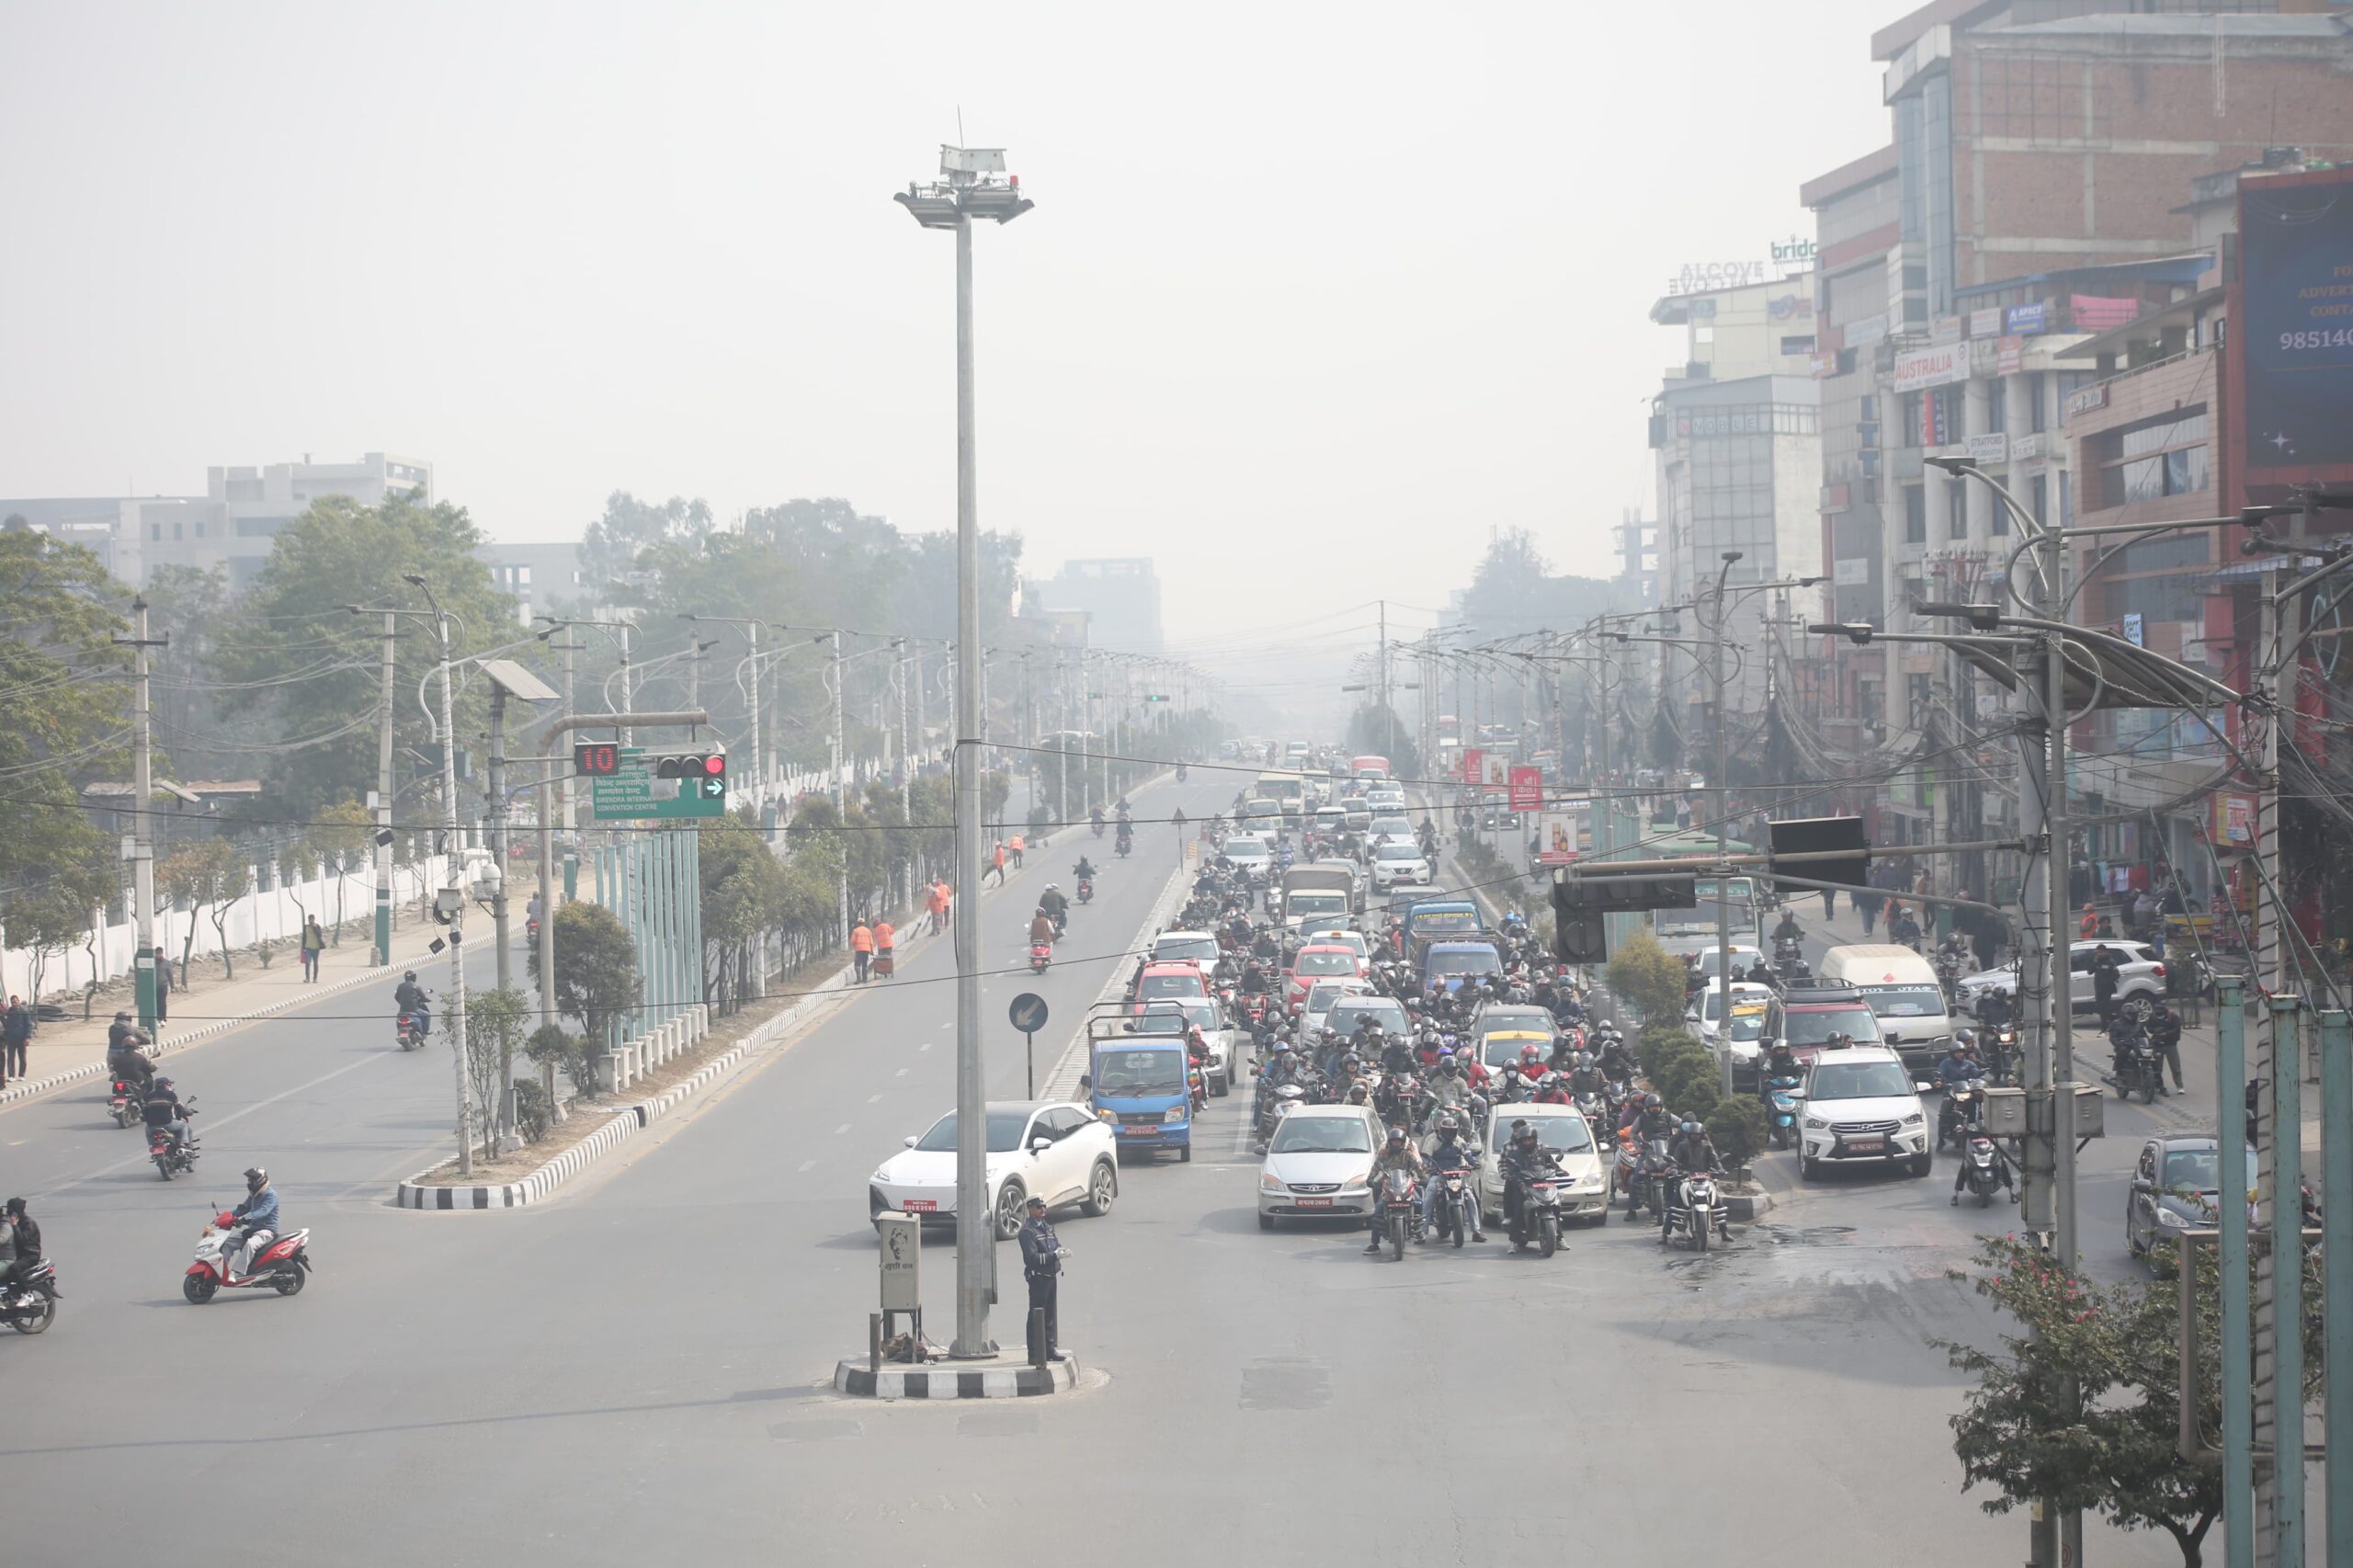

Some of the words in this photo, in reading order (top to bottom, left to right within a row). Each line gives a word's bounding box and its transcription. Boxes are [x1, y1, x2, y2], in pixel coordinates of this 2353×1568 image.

[1680, 261, 1764, 280] ALCOVE
[1895, 353, 1953, 381] AUSTRALIA
[1692, 416, 1755, 432] NOBLE
[583, 747, 613, 770] 10
[597, 796, 626, 804] BIRENDRA
